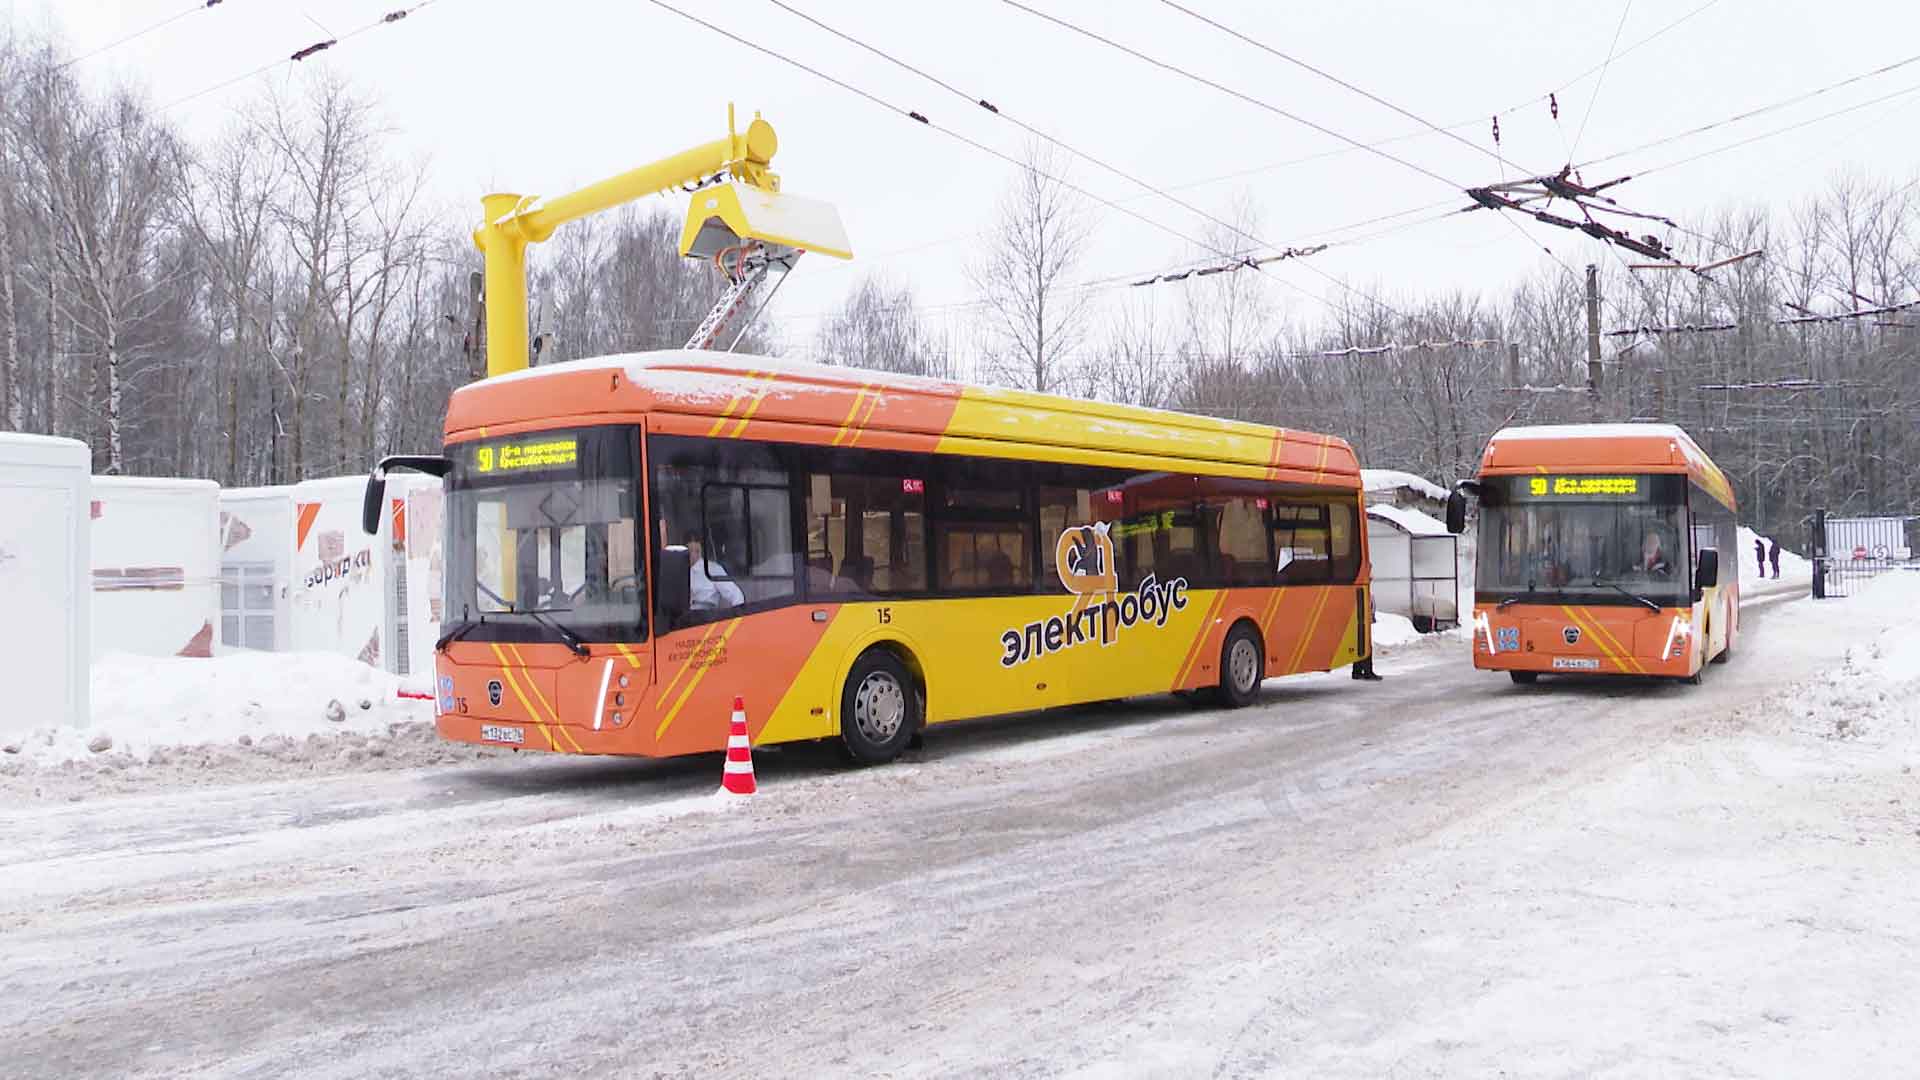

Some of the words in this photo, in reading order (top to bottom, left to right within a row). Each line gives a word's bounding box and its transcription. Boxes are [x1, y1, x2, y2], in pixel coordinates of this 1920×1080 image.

[479, 447, 494, 473] 50
[1530, 478, 1548, 495] 50
[877, 607, 891, 624] 15
[1001, 574, 1188, 667] электробус
[457, 697, 469, 714] 15
